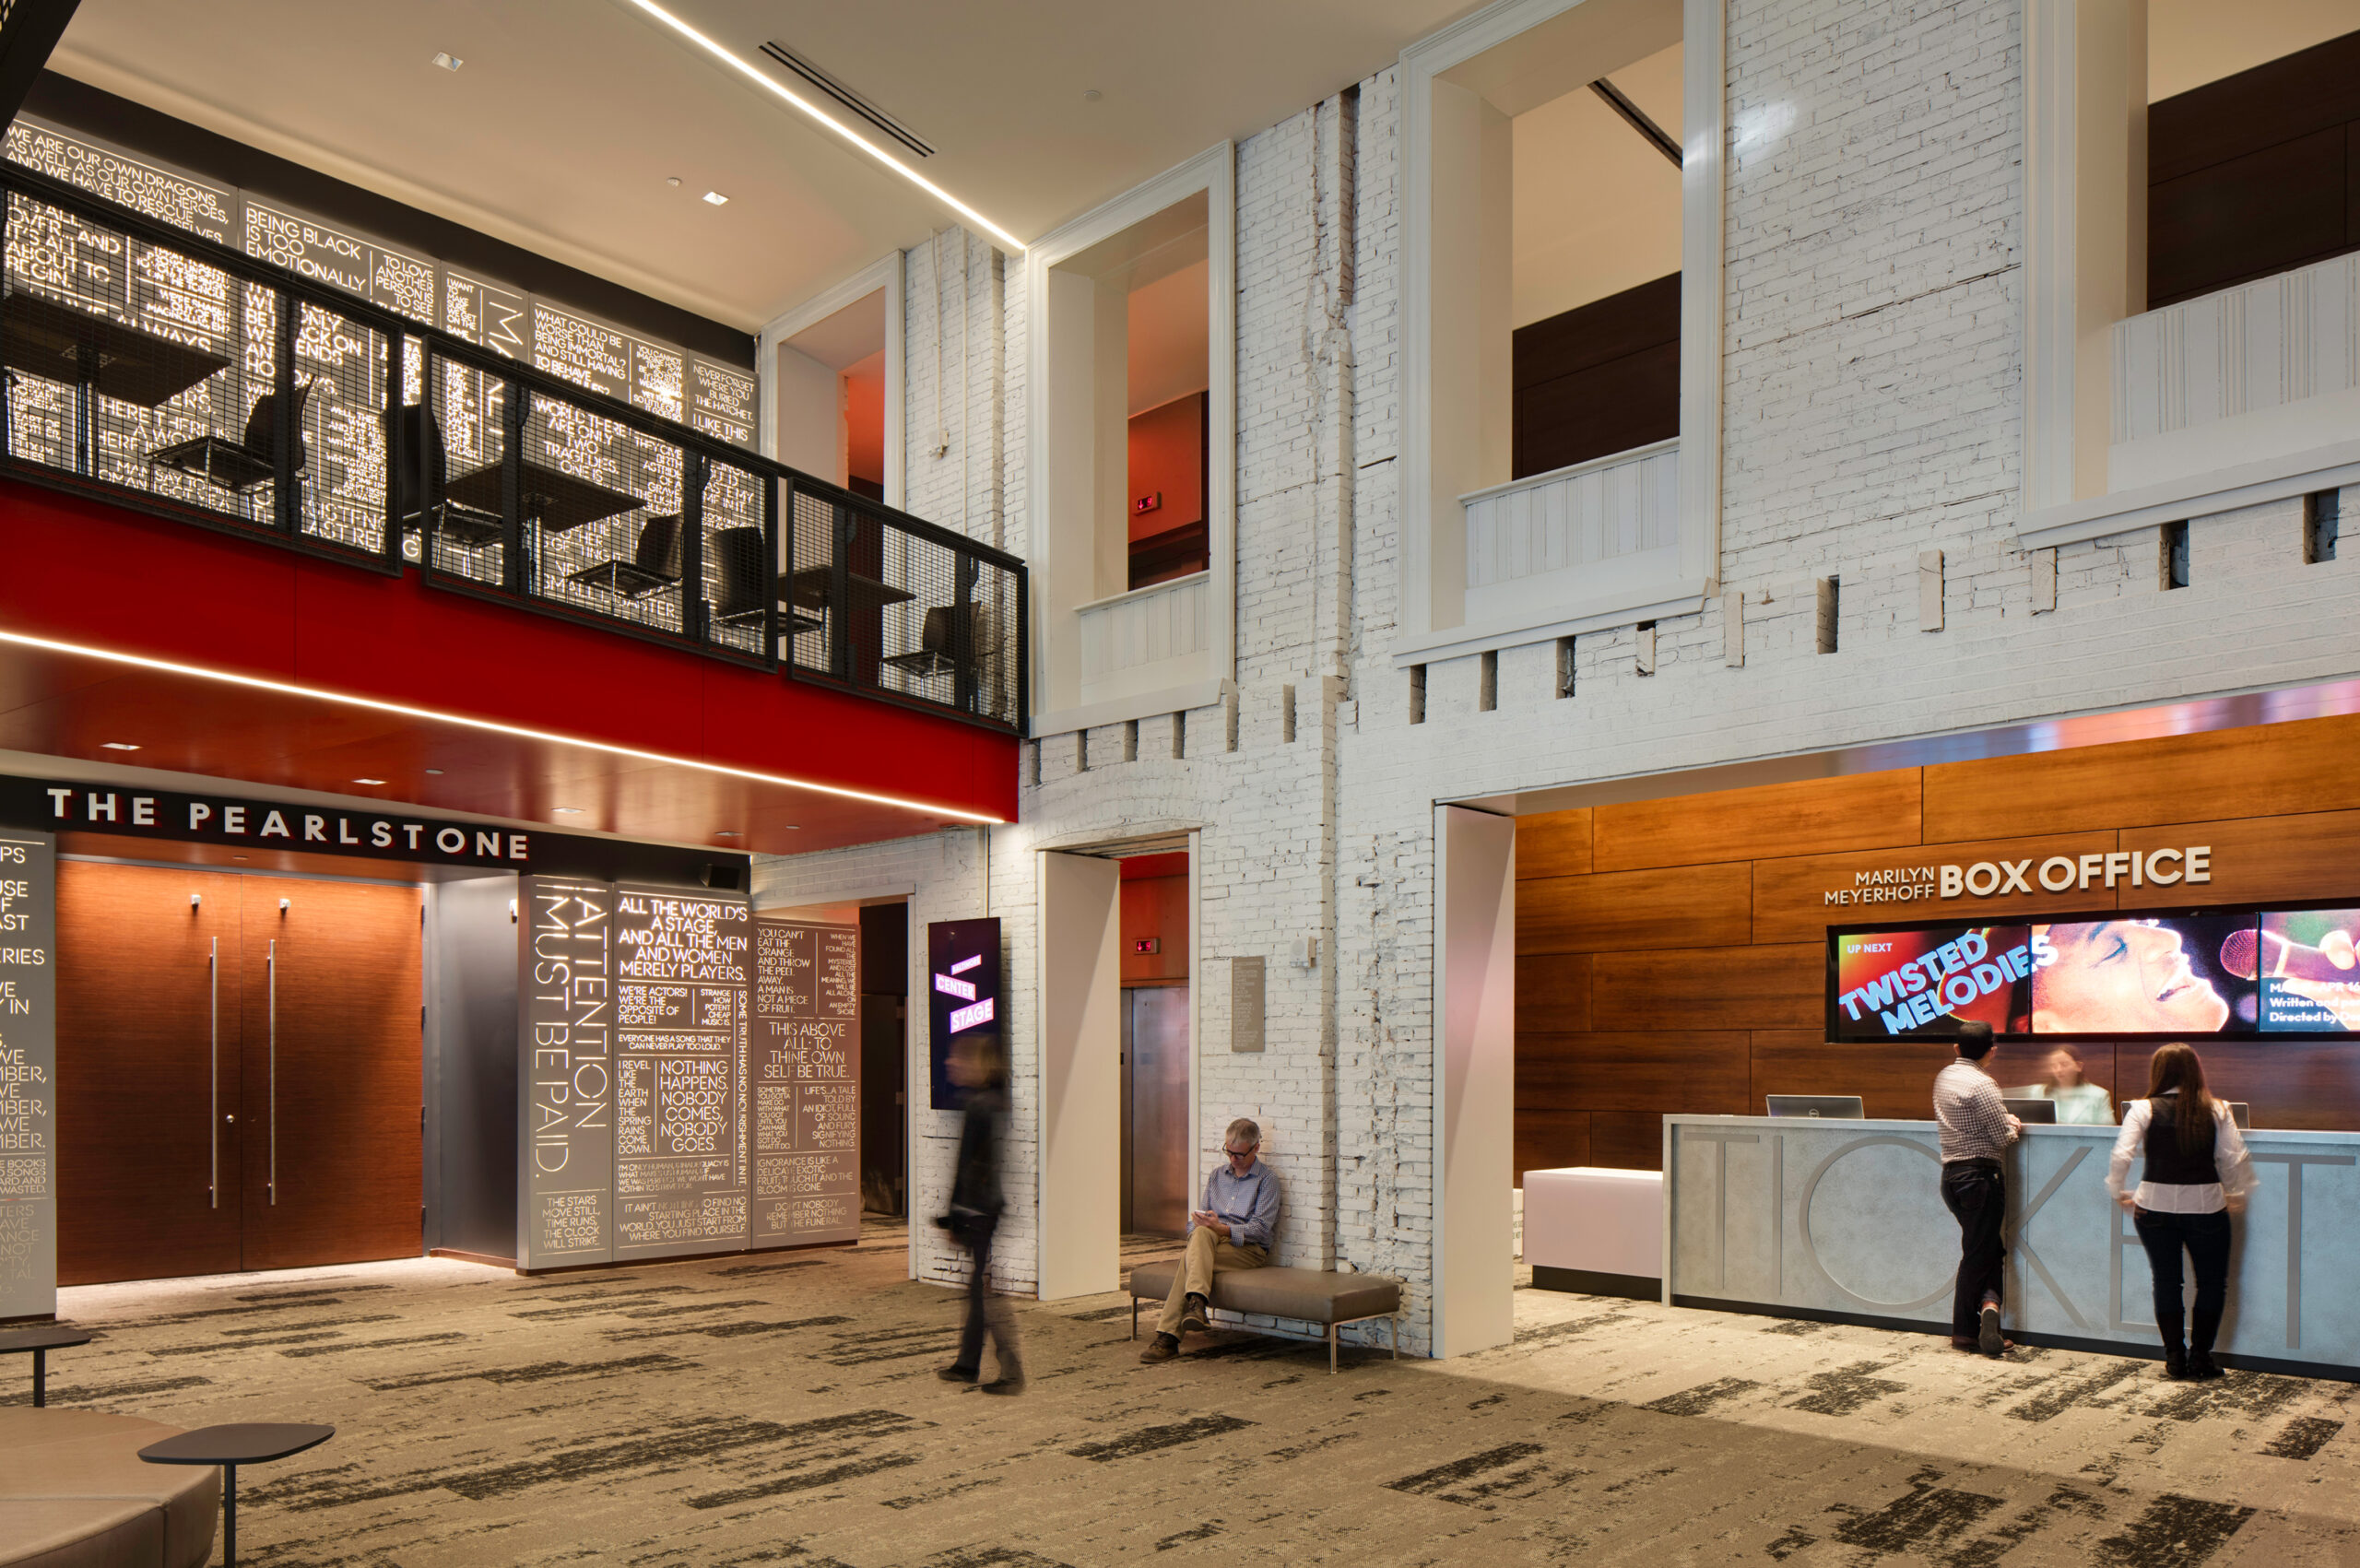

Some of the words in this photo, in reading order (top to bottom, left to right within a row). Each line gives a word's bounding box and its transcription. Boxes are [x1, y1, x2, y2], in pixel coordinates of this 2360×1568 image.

[7, 125, 31, 144] WE
[35, 135, 65, 155] ARE
[67, 146, 100, 167] OUR
[103, 159, 142, 181] OWN
[145, 171, 216, 206] DRAGONS
[6, 138, 28, 155] AS
[30, 145, 72, 170] WELL
[75, 161, 94, 177] AS
[97, 168, 129, 190] OUR
[132, 181, 169, 203] OWN
[171, 194, 229, 225] HEROES,
[7, 151, 41, 171] AND
[44, 162, 70, 183] WE
[73, 171, 112, 196] HAVE
[115, 186, 136, 203] TO
[138, 195, 194, 223] RESCUE
[246, 206, 300, 238] BEING
[303, 227, 361, 260] BLACK
[246, 223, 260, 242] IS
[264, 229, 304, 256] TOO
[246, 240, 367, 291] EMOTIONALLY
[384, 254, 400, 269] TO
[402, 262, 433, 282] LOVE
[376, 265, 433, 291] ANOTHER
[376, 277, 422, 301] PERSON
[424, 291, 433, 304] IS
[395, 293, 411, 308] TO
[413, 300, 433, 316] SEE
[535, 308, 567, 328] WHAT
[568, 321, 608, 343] COULD
[609, 336, 622, 348] BE
[535, 319, 573, 341] WORSE
[575, 333, 605, 352] THAN
[535, 330, 566, 348] BEING
[568, 341, 627, 369] IMMORTAL?
[535, 341, 559, 357] AND
[560, 349, 586, 367] STILL
[587, 358, 626, 380] HAVING
[535, 354, 549, 368] TO
[551, 360, 592, 382] BEHAVE
[693, 363, 721, 382] NEVER
[721, 374, 754, 393] FORGET
[699, 376, 728, 395] WHERE
[730, 386, 749, 400] YOU
[695, 394, 712, 407] THE
[713, 400, 752, 421] HATCHET.
[709, 389, 739, 407] BURIED
[698, 415, 721, 433] LIKE
[723, 422, 749, 442] THIS
[47, 787, 157, 826] THE
[189, 802, 530, 861] PEARLSTONE
[1855, 866, 1935, 886] MARILYN
[1940, 858, 2035, 899] BOX
[2038, 845, 2212, 892] OFFICE
[1824, 882, 1935, 906] MEYERHOFF
[619, 897, 648, 914] ALL
[650, 900, 678, 916] THE
[681, 902, 748, 922] WORLD'S
[651, 915, 664, 931] A
[666, 916, 717, 937] STAGE,
[619, 929, 655, 946] AND
[656, 931, 684, 948] ALL
[686, 933, 714, 949] THE
[716, 935, 748, 951] MEN
[1847, 943, 1861, 954] UP
[1863, 942, 1894, 953] NEXT
[535, 894, 570, 1011] MUST
[635, 946, 670, 962] AND
[673, 948, 733, 965] WOMEN
[620, 961, 678, 977] MERELY
[681, 964, 747, 981] PLAYERS.
[758, 957, 777, 966] AND
[778, 957, 810, 968] THROW
[1838, 933, 1988, 1022] TWISTED
[1880, 935, 2059, 1035] MELODIES
[618, 984, 647, 996] WE'RE
[649, 986, 688, 997] ACTORS!
[937, 976, 974, 1000] CENTER
[618, 996, 647, 1005] WE'RE
[649, 996, 666, 1006] THE
[618, 1005, 664, 1016] OPPOSITE
[666, 1007, 679, 1016] OF
[738, 990, 747, 1020] SOME
[2270, 997, 2314, 1008] Written
[574, 895, 608, 1127] ATTENTION
[618, 1014, 656, 1025] PEOPLE!
[952, 1000, 992, 1031] STAGE
[2270, 1012, 2321, 1022] Directed
[2323, 1012, 2337, 1024] by
[738, 1021, 747, 1053] TRUTH
[769, 1021, 796, 1036] THIS
[800, 1023, 846, 1037] ABOVE
[536, 1022, 570, 1069] BE
[784, 1036, 811, 1050] ALL:
[814, 1036, 832, 1051] TO
[623, 1060, 651, 1069] REVEL
[738, 1055, 747, 1075] HAS
[769, 1051, 808, 1064] THINE
[811, 1051, 845, 1064] OWN
[618, 1069, 637, 1079] LIKE
[660, 1060, 728, 1075] NOTHING
[763, 1064, 795, 1079] SELF
[797, 1064, 813, 1079] BE
[815, 1064, 850, 1079] TRUE.
[618, 1088, 649, 1098] EARTH
[619, 1079, 636, 1088] THE
[660, 1076, 729, 1091] HAPPENS.
[738, 1077, 747, 1092] NO
[618, 1098, 647, 1107] WHEN
[661, 1091, 727, 1106] NOBODY
[618, 1115, 652, 1126] SPRING
[619, 1107, 636, 1116] THE
[665, 1106, 723, 1122] COMES,
[536, 1081, 569, 1178] PAID.
[618, 1126, 645, 1136] RAINS
[660, 1121, 728, 1138] NOBODY
[738, 1093, 747, 1163] NOURISHMENT
[618, 1136, 647, 1145] COME
[618, 1145, 652, 1154] DOWN.
[671, 1137, 717, 1152] GOES.
[7, 1159, 46, 1169] BOOKS
[7, 1167, 46, 1177] SONGS
[738, 1166, 747, 1174] IN
[547, 1197, 566, 1208] THE
[568, 1195, 597, 1207] STARS
[542, 1208, 572, 1219] MOVE
[573, 1206, 601, 1217] STILL,
[546, 1217, 568, 1228] TIME
[570, 1215, 597, 1227] RUNS,
[544, 1228, 562, 1239] THE
[564, 1226, 599, 1237] CLOCK
[544, 1239, 566, 1249] WILL
